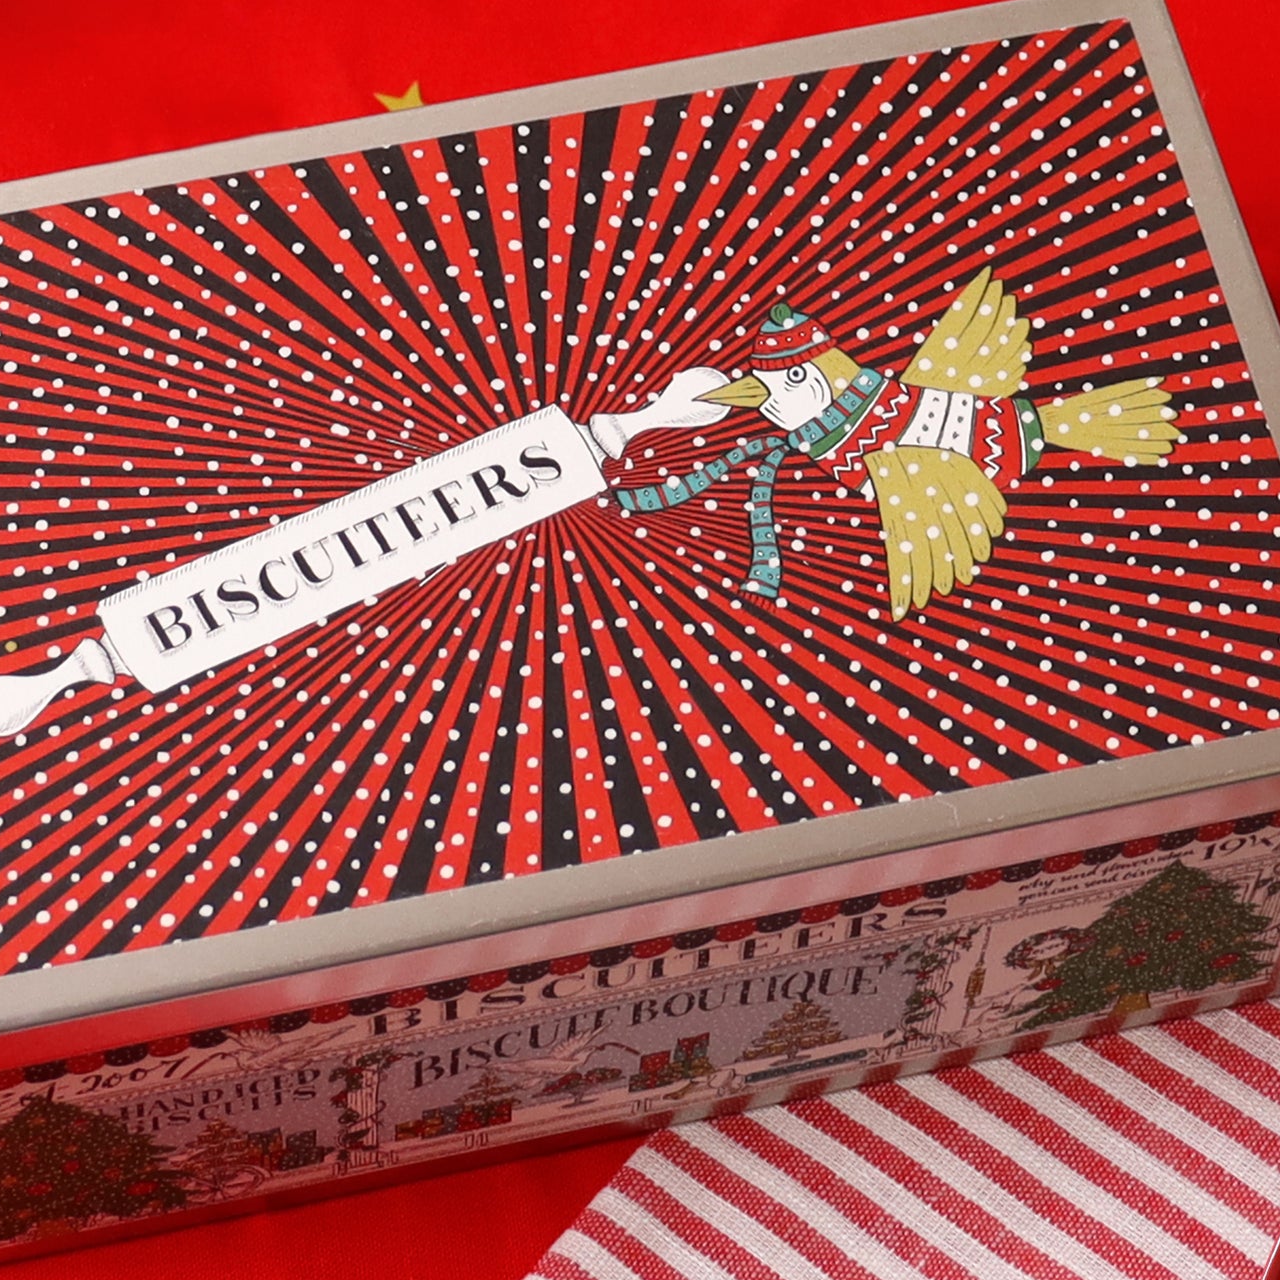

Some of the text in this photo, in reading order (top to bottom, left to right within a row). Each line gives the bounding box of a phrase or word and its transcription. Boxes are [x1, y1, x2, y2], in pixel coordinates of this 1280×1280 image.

[145, 441, 562, 653] BISCUITEERS
[367, 899, 949, 1036] BISCUITEERS
[413, 964, 885, 1089] BISCUIT BOUTIQUE
[76, 1055, 191, 1096] 2007
[120, 1068, 321, 1121] HAND ICED
